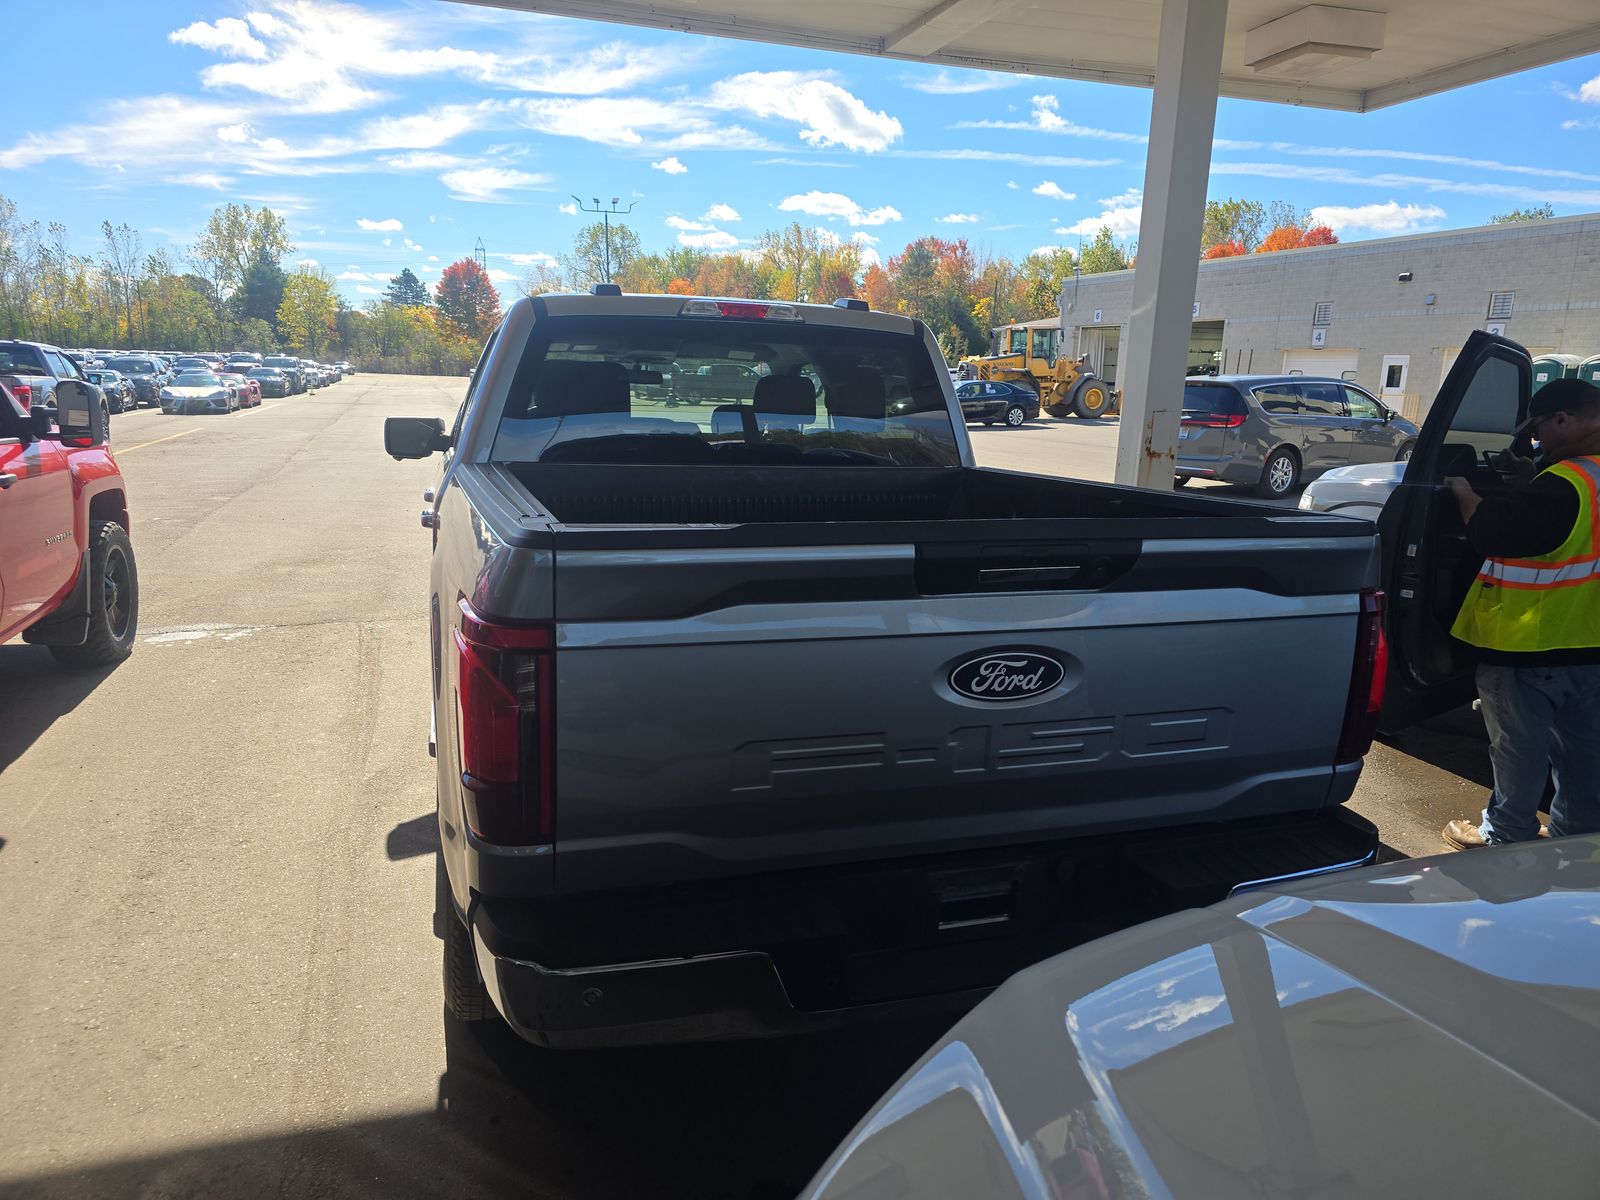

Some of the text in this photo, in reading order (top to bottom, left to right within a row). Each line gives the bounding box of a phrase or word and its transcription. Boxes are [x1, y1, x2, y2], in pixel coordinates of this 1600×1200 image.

[1315, 332, 1322, 342] 4
[971, 660, 1046, 692] Ford
[731, 706, 1236, 792] F-150
